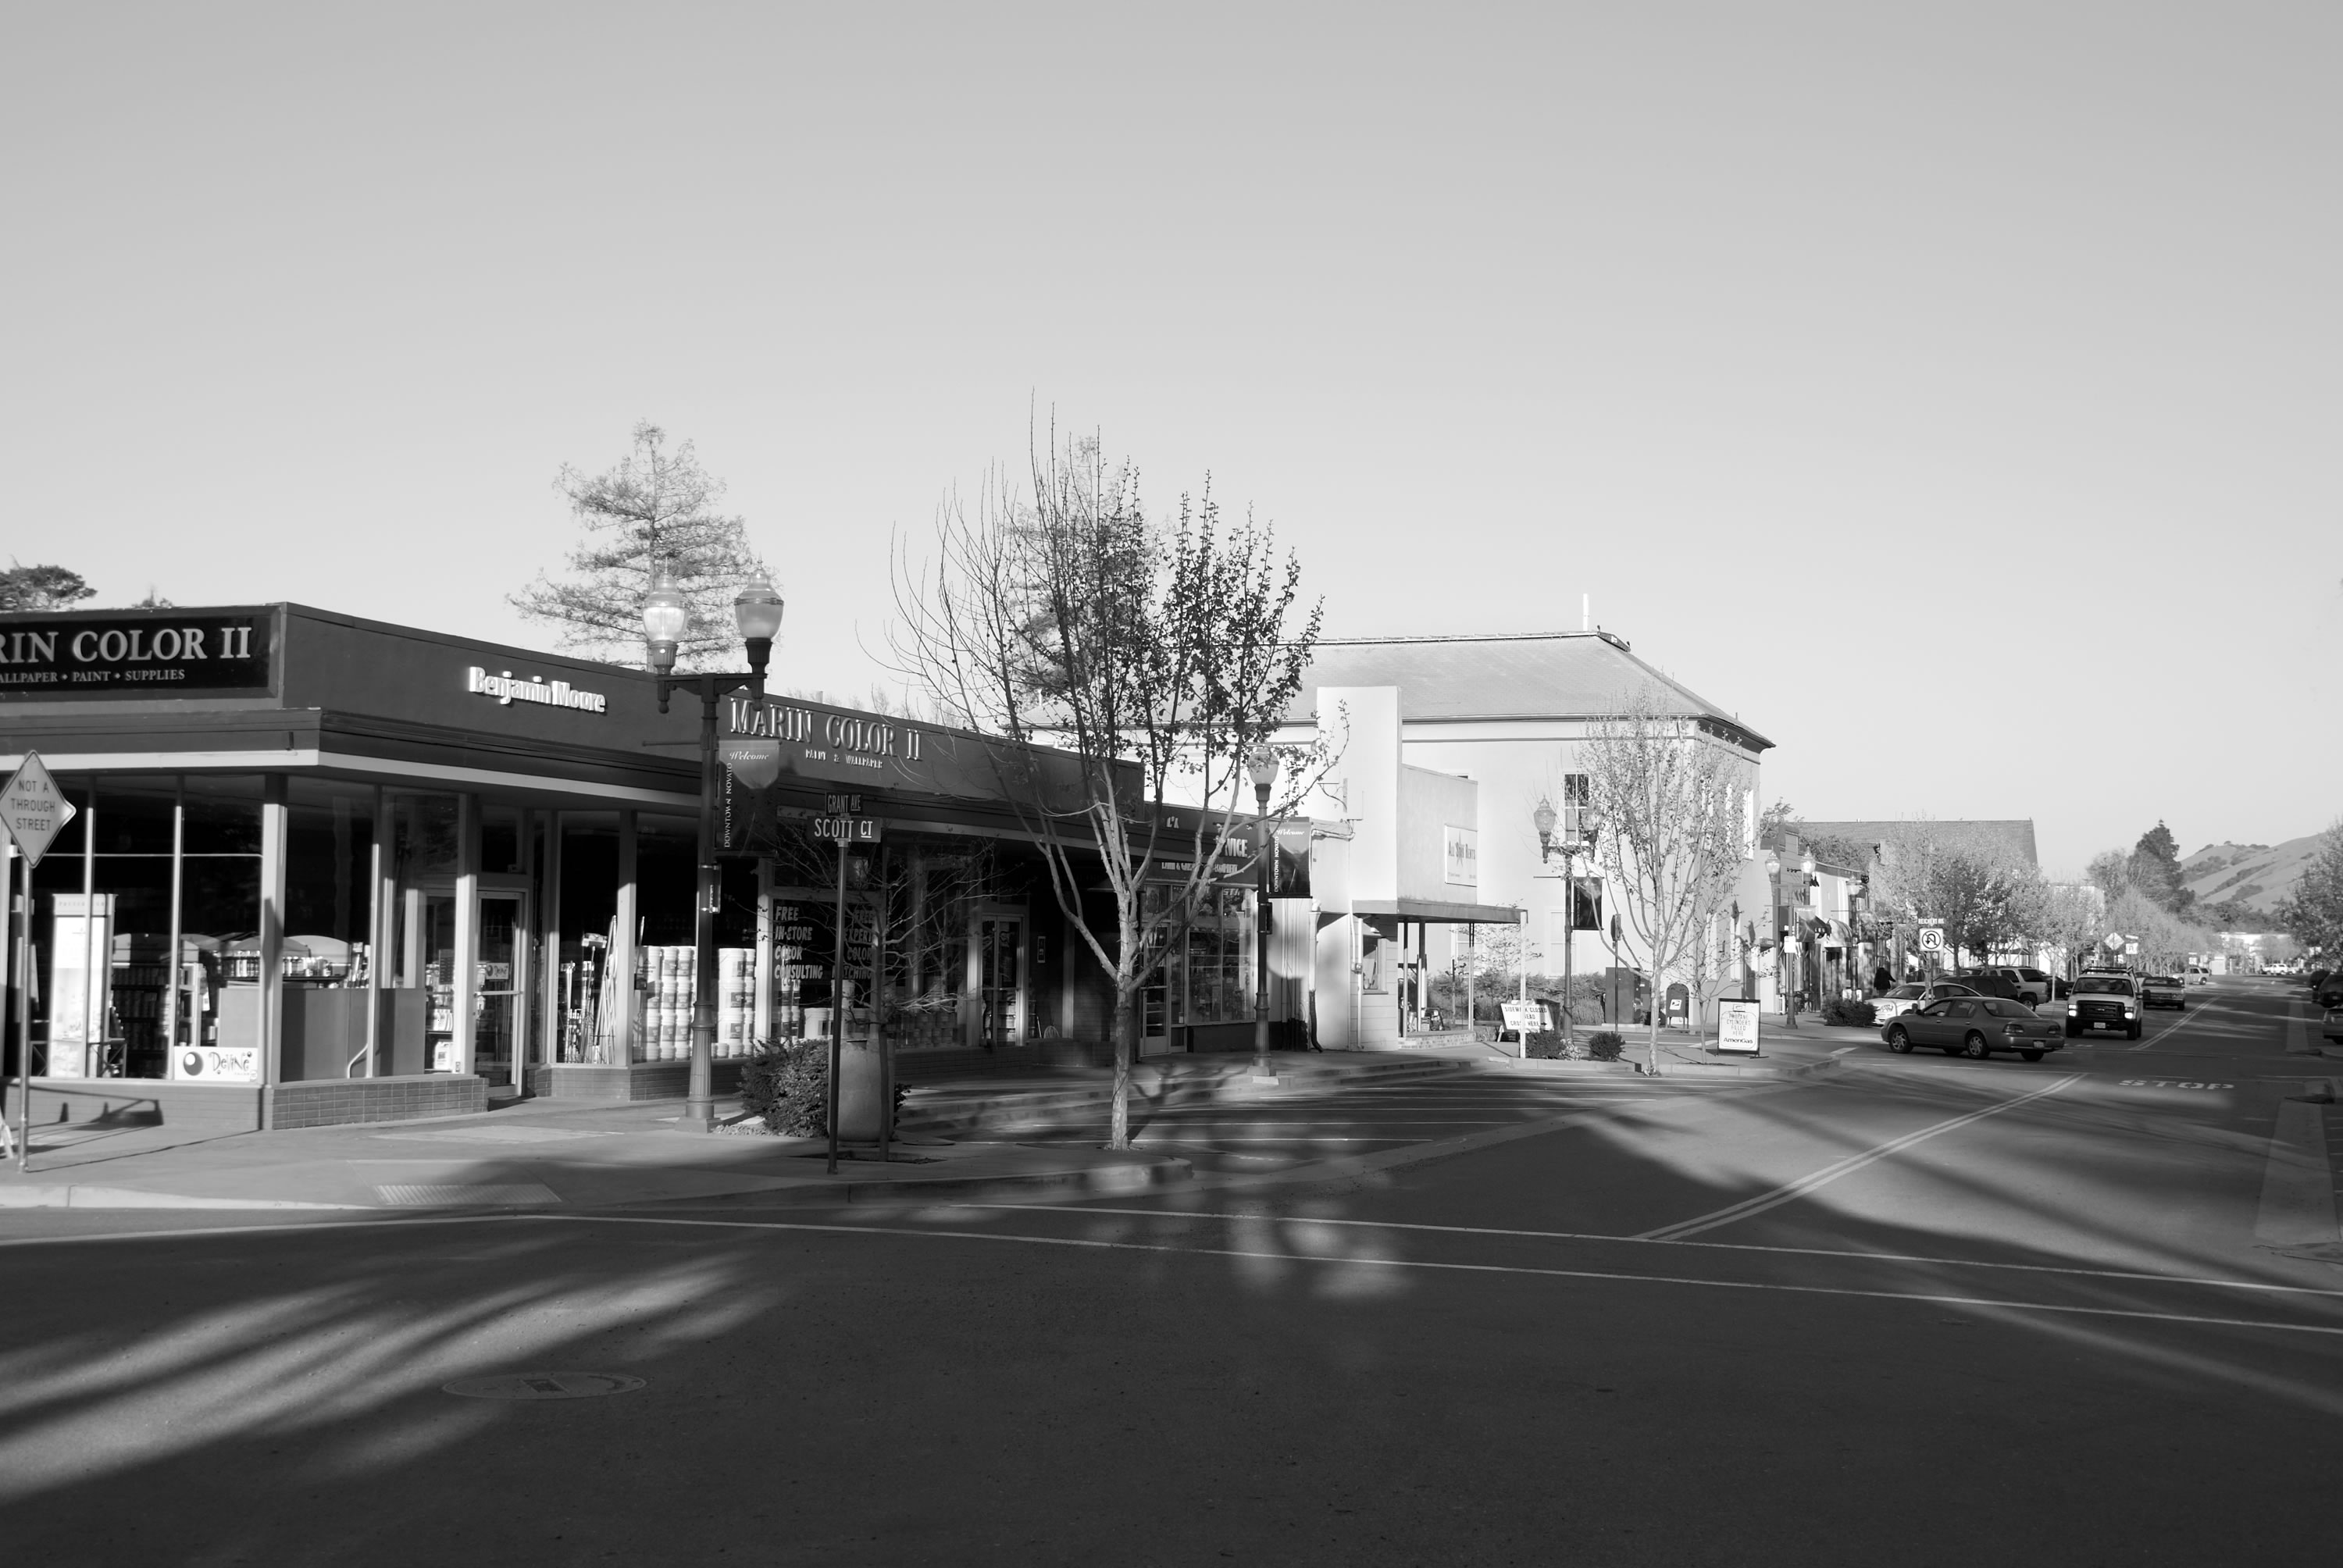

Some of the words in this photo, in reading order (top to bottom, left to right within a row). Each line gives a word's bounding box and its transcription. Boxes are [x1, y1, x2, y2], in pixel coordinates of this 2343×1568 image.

[73, 628, 208, 662] COLOR
[219, 626, 252, 658] II
[73, 671, 111, 682] PAINT
[125, 668, 185, 681] SUPPLIES
[469, 666, 551, 705] Benjamin
[551, 680, 606, 713] Moore
[731, 697, 814, 743] MARIN
[826, 715, 897, 757] COLOR
[907, 728, 923, 761] II
[729, 750, 769, 761] Welcome
[805, 748, 826, 761] PAINT
[845, 754, 883, 769] WALLPAPER
[18, 780, 37, 793] NOT
[43, 782, 49, 793] A
[10, 798, 55, 813] THROUGH
[828, 794, 849, 813] GRANT
[851, 794, 861, 810] AVE
[16, 818, 51, 831] STREET
[814, 818, 854, 838] SCOTT
[860, 820, 873, 837] CT
[776, 906, 799, 921] FREE
[776, 926, 812, 941] IN-STORE
[775, 945, 803, 960] COLOR
[774, 964, 823, 979] CONSULTING
[832, 965, 872, 979] TCHING
[2118, 1079, 2234, 1089] STOP
